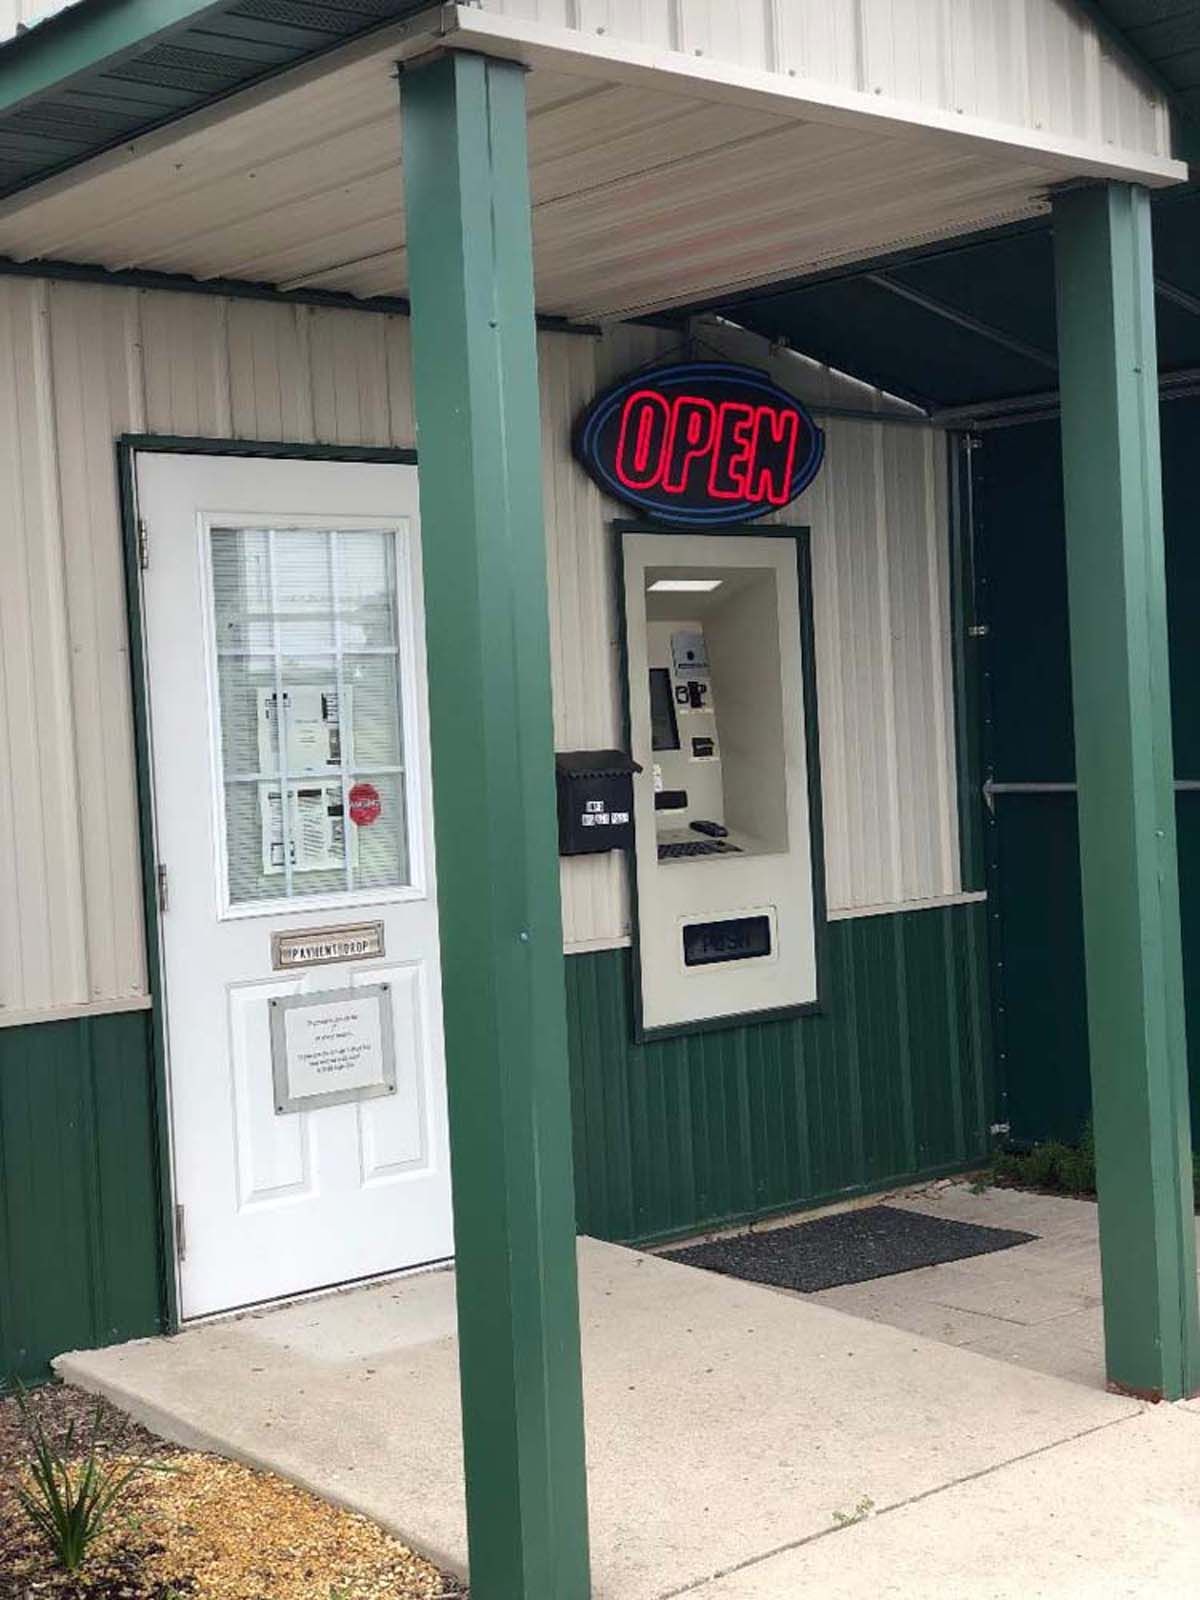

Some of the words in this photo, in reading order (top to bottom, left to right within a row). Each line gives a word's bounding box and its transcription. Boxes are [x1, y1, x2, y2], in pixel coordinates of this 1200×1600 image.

[615, 390, 799, 505] OPEN
[292, 943, 337, 960] PAYMENT
[344, 940, 369, 955] DROP
